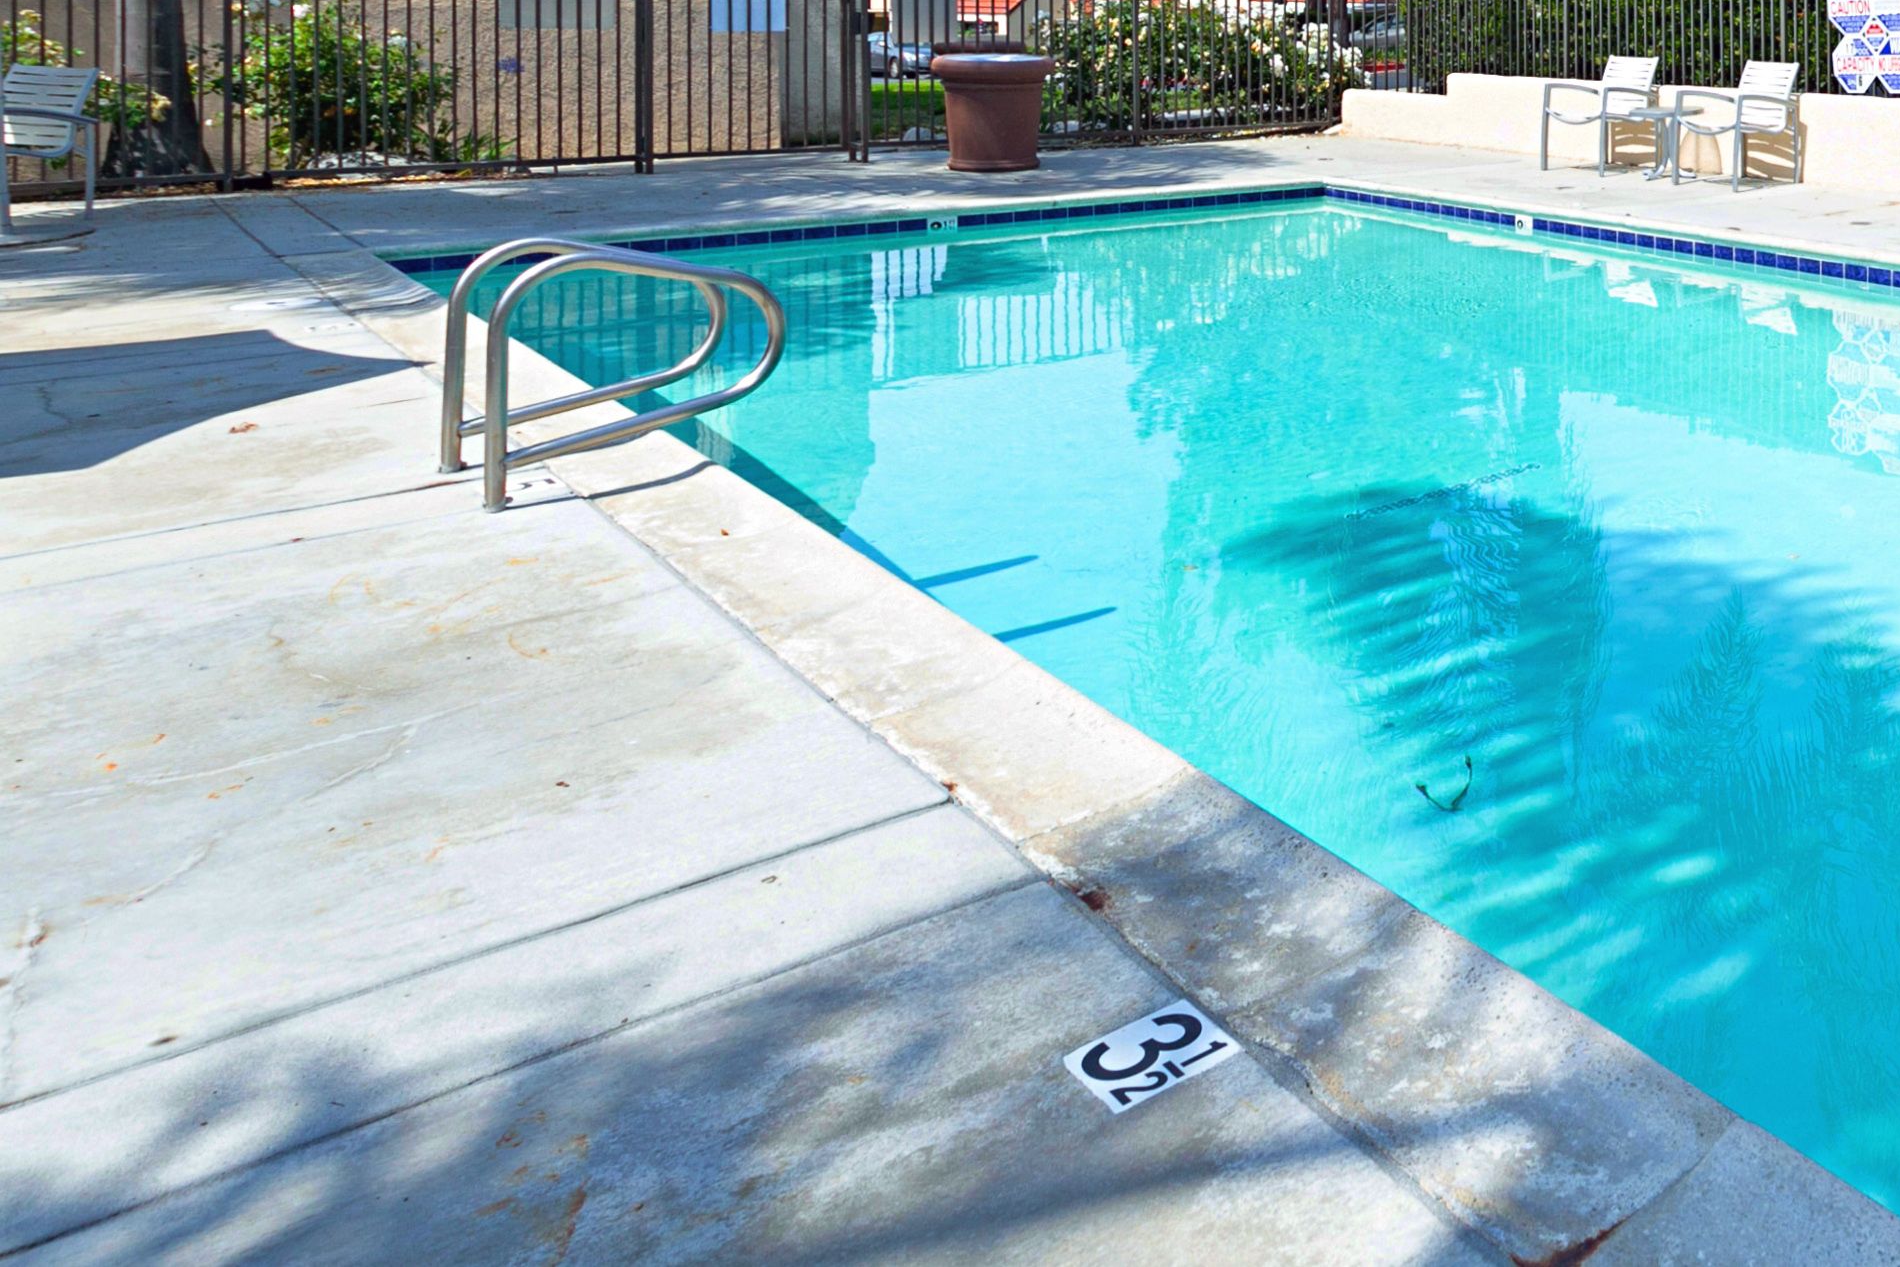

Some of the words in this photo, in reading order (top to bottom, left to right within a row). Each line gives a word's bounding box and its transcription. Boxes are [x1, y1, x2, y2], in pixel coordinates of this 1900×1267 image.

[1830, 0, 1871, 15] CAUTION
[1836, 56, 1875, 73] CAPACITY
[1878, 56, 1886, 72] NO
[1080, 1012, 1203, 1081] 3
